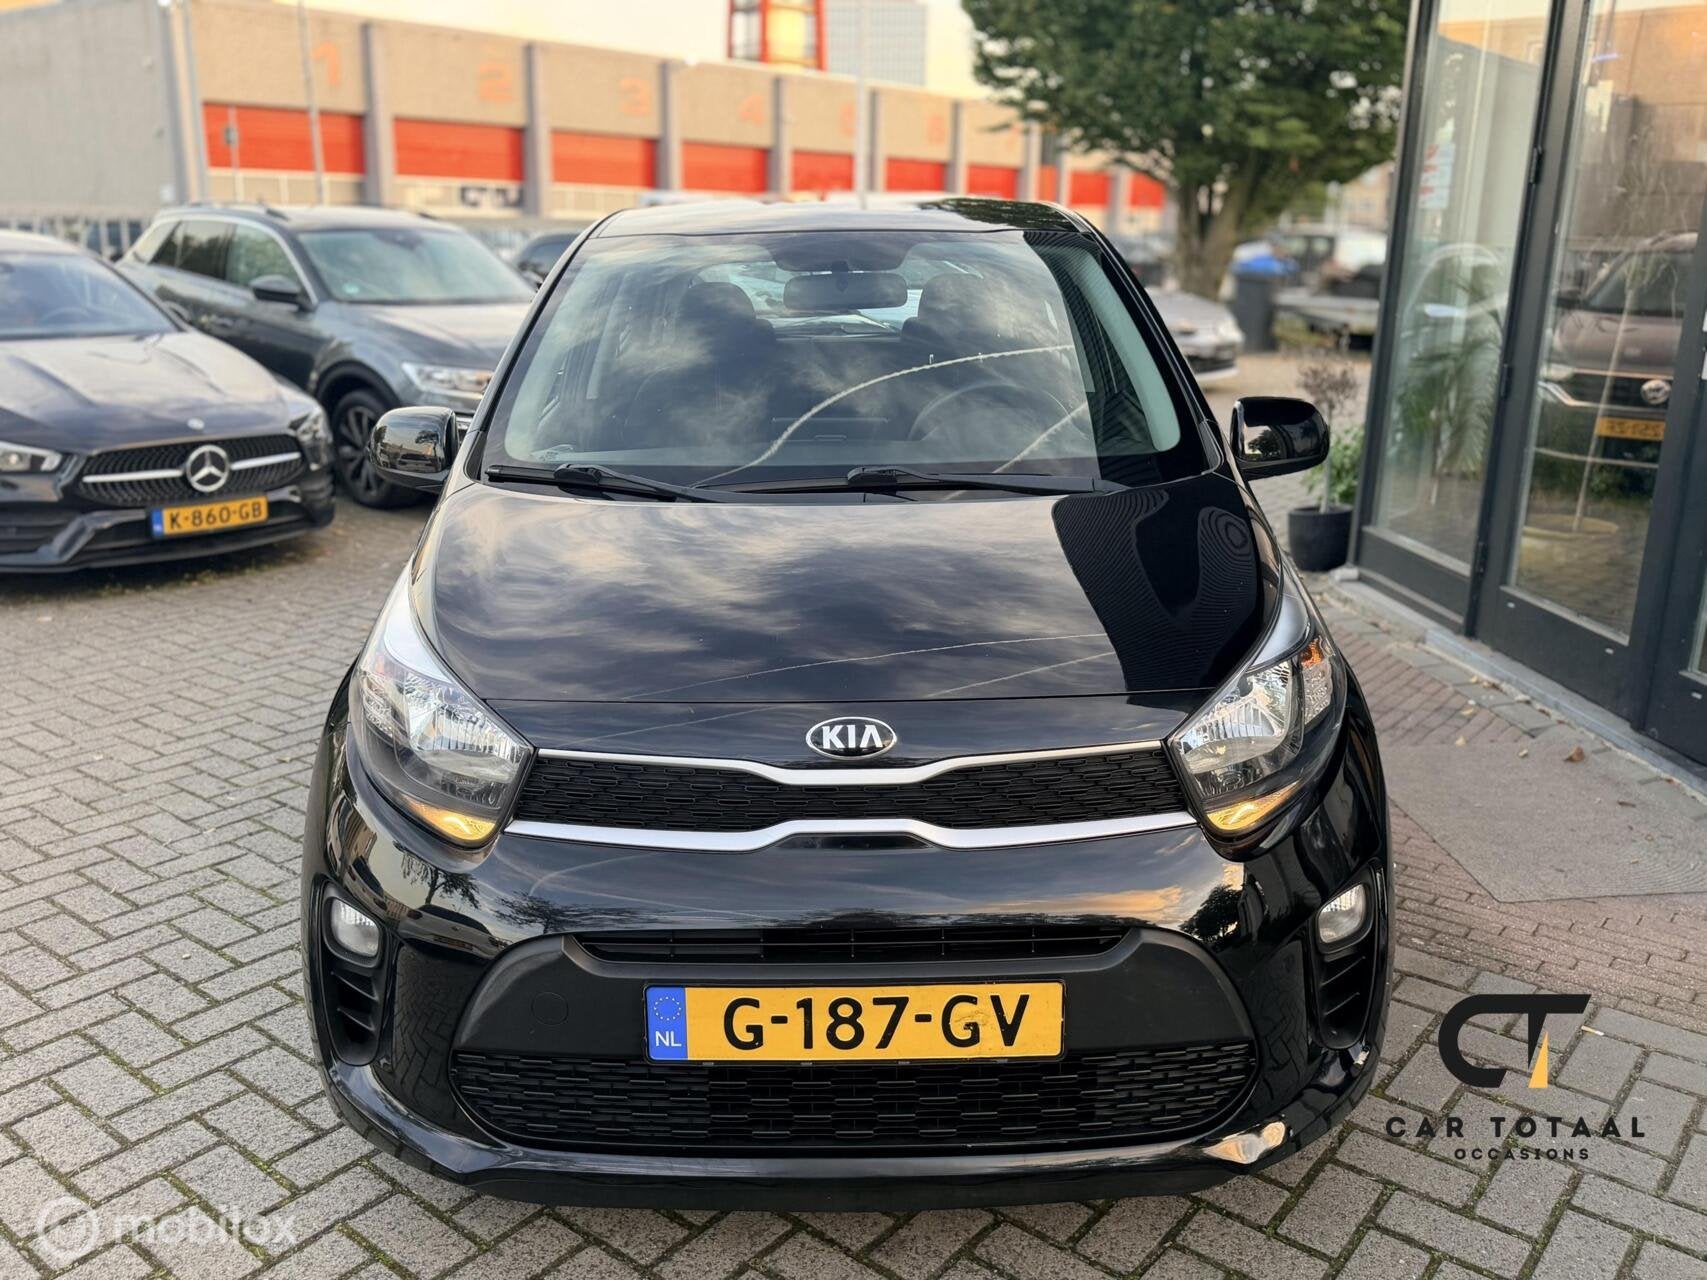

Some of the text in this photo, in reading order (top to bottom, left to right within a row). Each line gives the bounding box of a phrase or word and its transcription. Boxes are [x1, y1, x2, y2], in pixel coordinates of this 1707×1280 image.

[169, 501, 262, 530] K-860-GB
[821, 724, 884, 749] KIA
[723, 994, 1030, 1051] G-187-GV
[655, 1030, 682, 1048] NL
